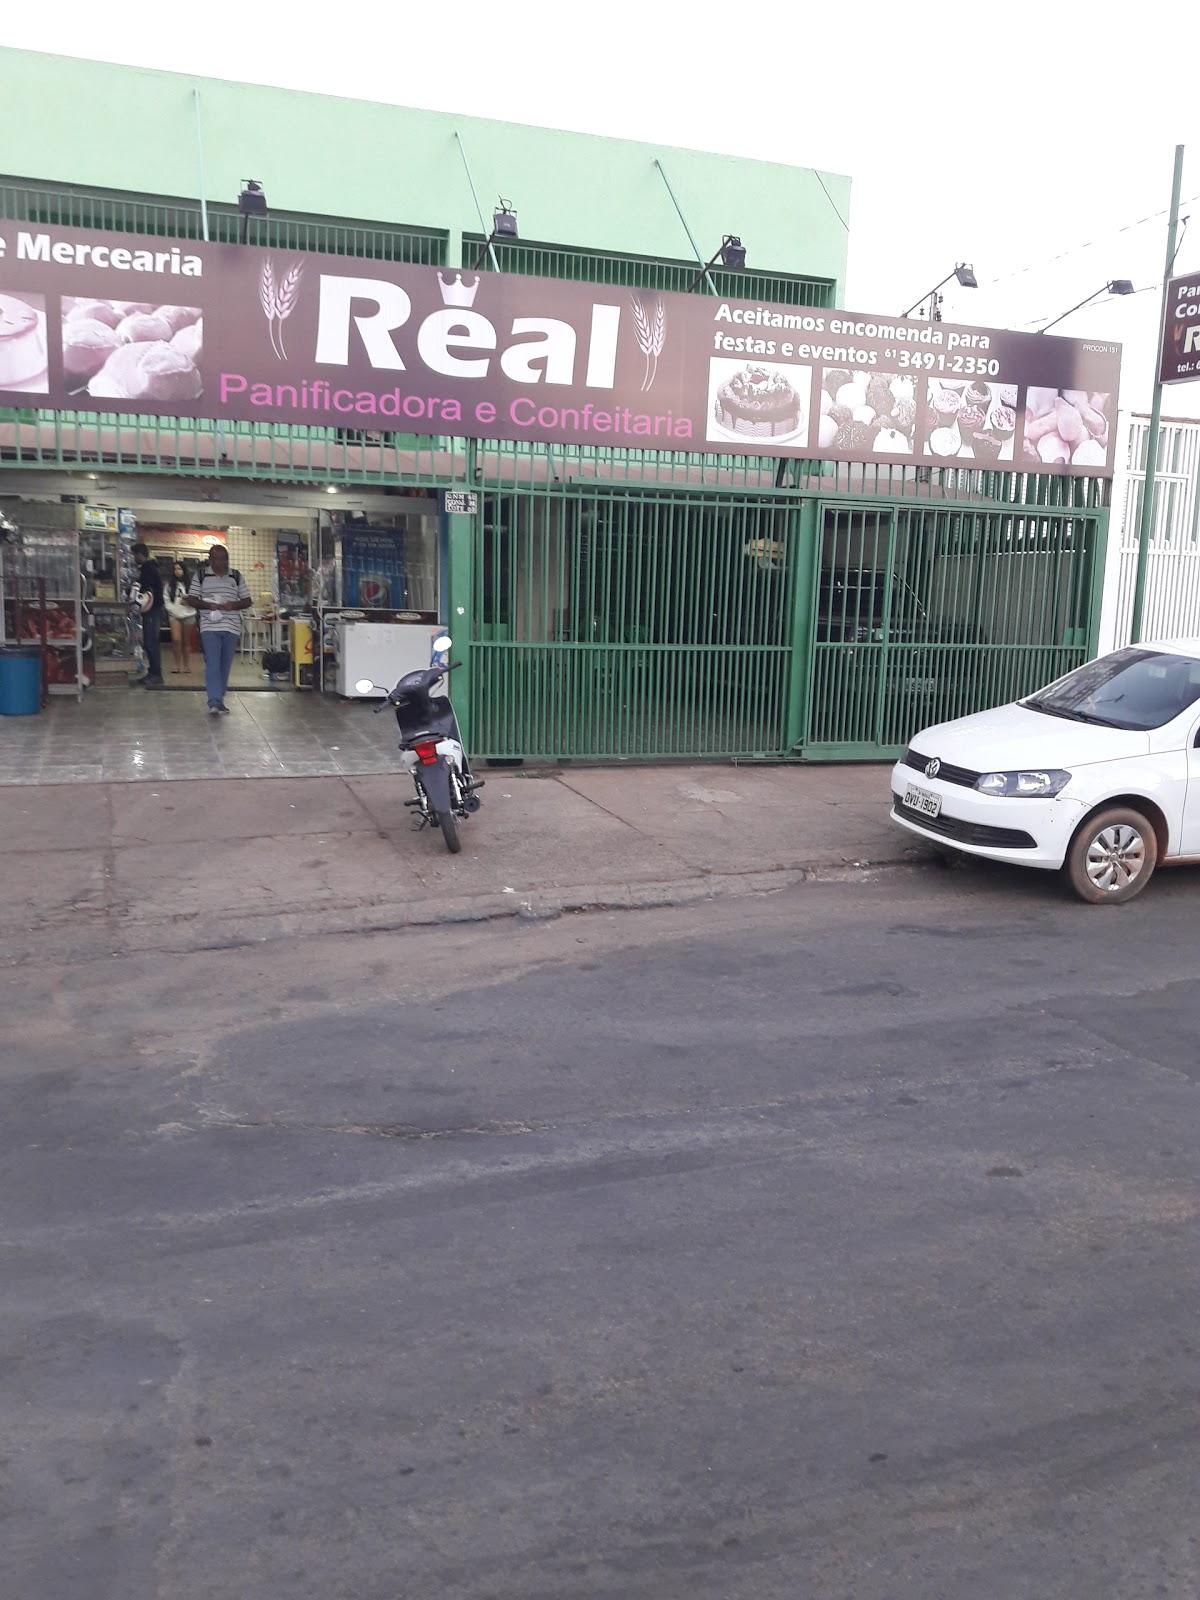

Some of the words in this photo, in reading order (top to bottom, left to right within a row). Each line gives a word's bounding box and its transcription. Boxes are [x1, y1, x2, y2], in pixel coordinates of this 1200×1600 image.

[17, 231, 203, 276] Mercearia
[1175, 303, 1200, 319] Co
[1177, 285, 1200, 299] Pa
[315, 274, 621, 389] Real
[714, 303, 825, 332] Aceitamos
[829, 319, 944, 345] encomenda
[947, 332, 990, 350] para
[1082, 343, 1108, 353] PROCON
[714, 331, 776, 355] festas
[781, 342, 794, 357] e
[798, 343, 878, 365] eventos
[884, 348, 897, 359] 61
[898, 350, 1000, 376] 3491-2350
[220, 373, 461, 421] Panificadora
[475, 402, 497, 423] e
[510, 398, 693, 438] Confeitaria
